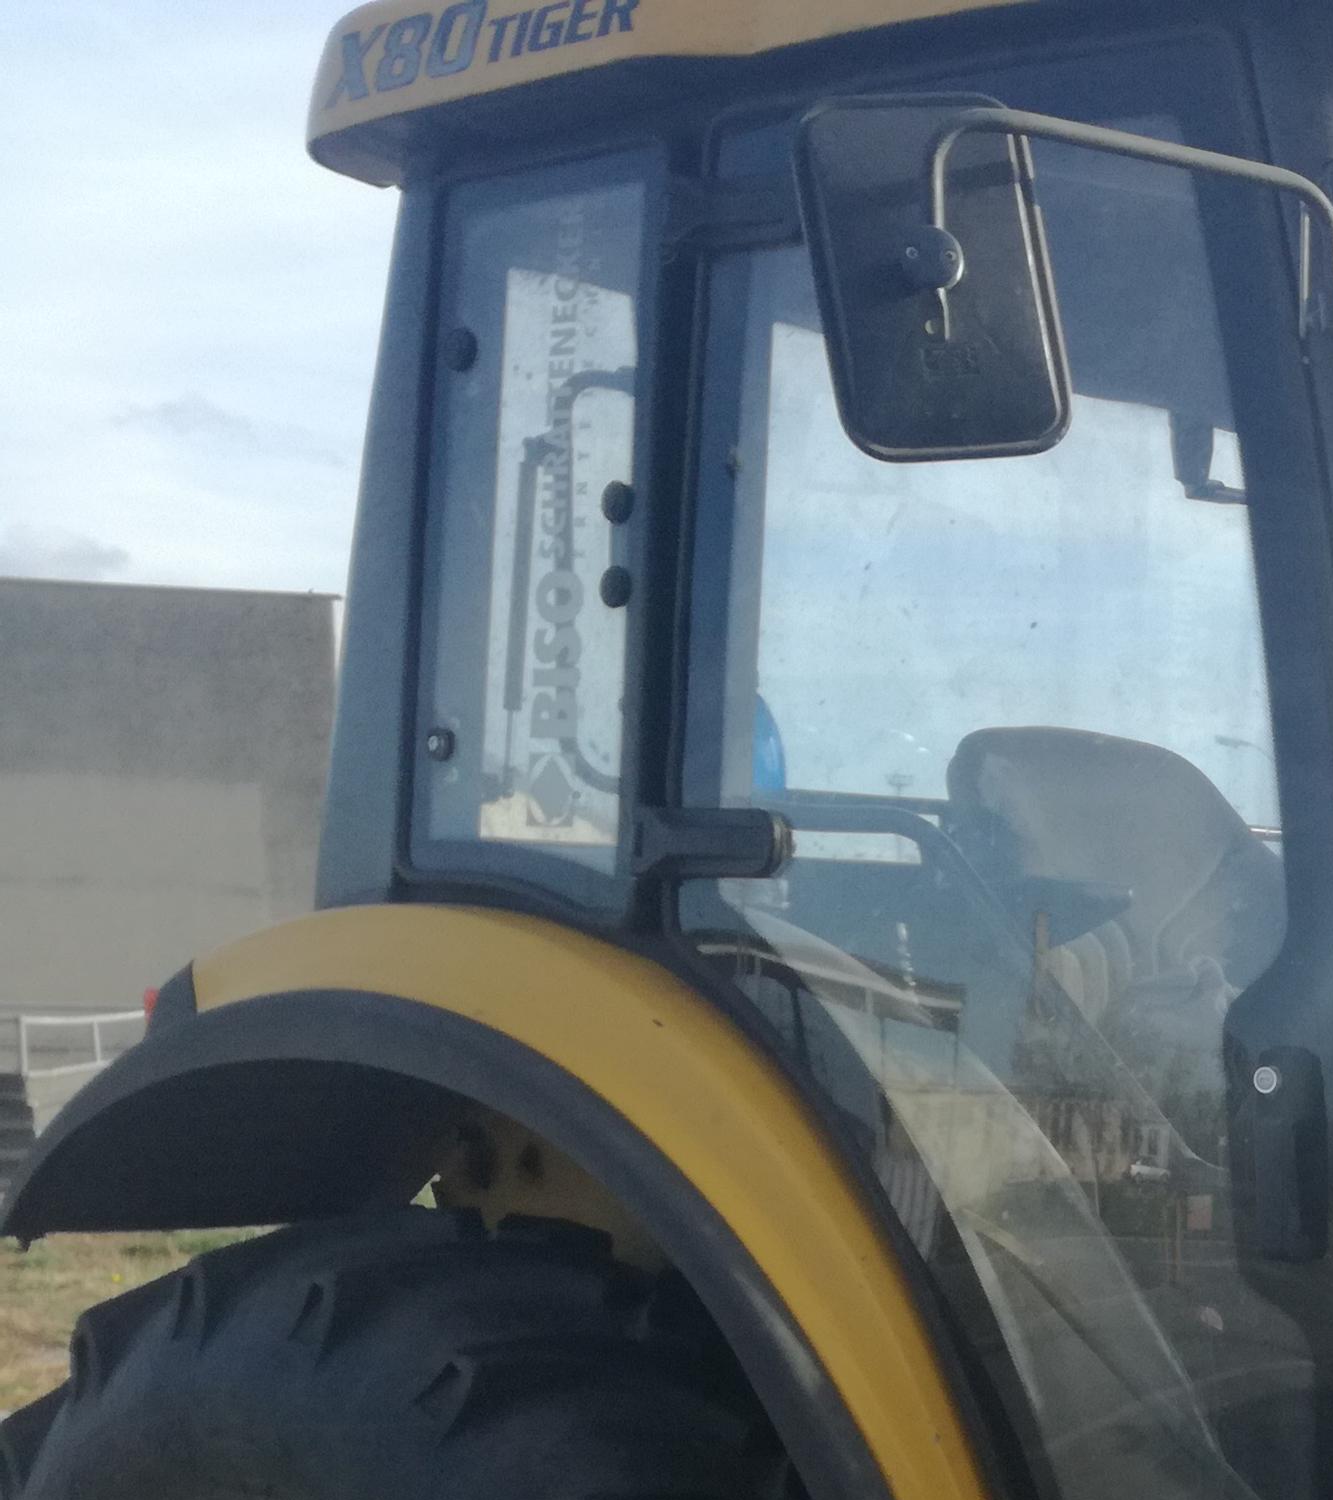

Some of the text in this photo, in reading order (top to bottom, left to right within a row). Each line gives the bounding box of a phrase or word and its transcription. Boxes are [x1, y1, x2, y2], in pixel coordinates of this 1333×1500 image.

[325, 0, 639, 109] X80 TIGER
[530, 569, 584, 738] BISO
